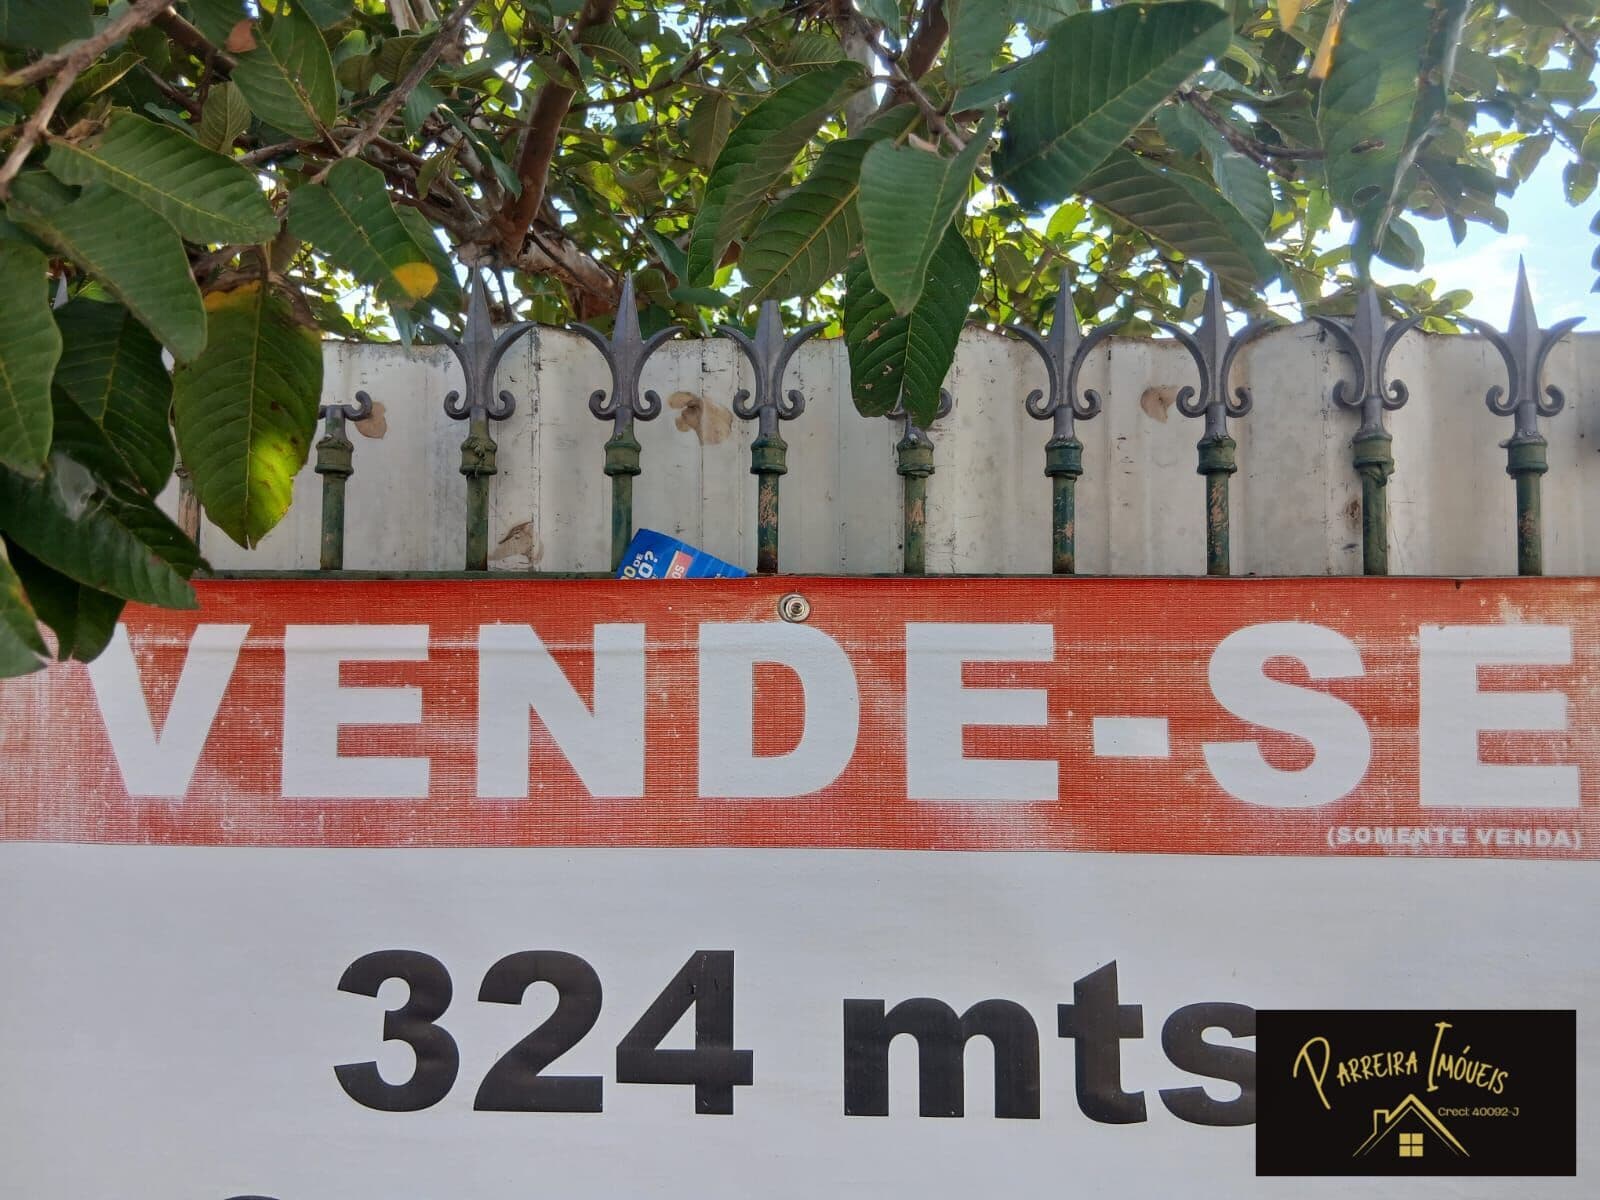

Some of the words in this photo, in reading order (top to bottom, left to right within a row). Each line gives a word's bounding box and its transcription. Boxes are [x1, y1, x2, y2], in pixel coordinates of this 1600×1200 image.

[87, 621, 1581, 808] VENDE-SE
[1327, 826, 1468, 848] (SOMENTE
[1475, 828, 1582, 850] VENDA)
[334, 950, 754, 1115] 324
[843, 959, 1256, 1127] mts
